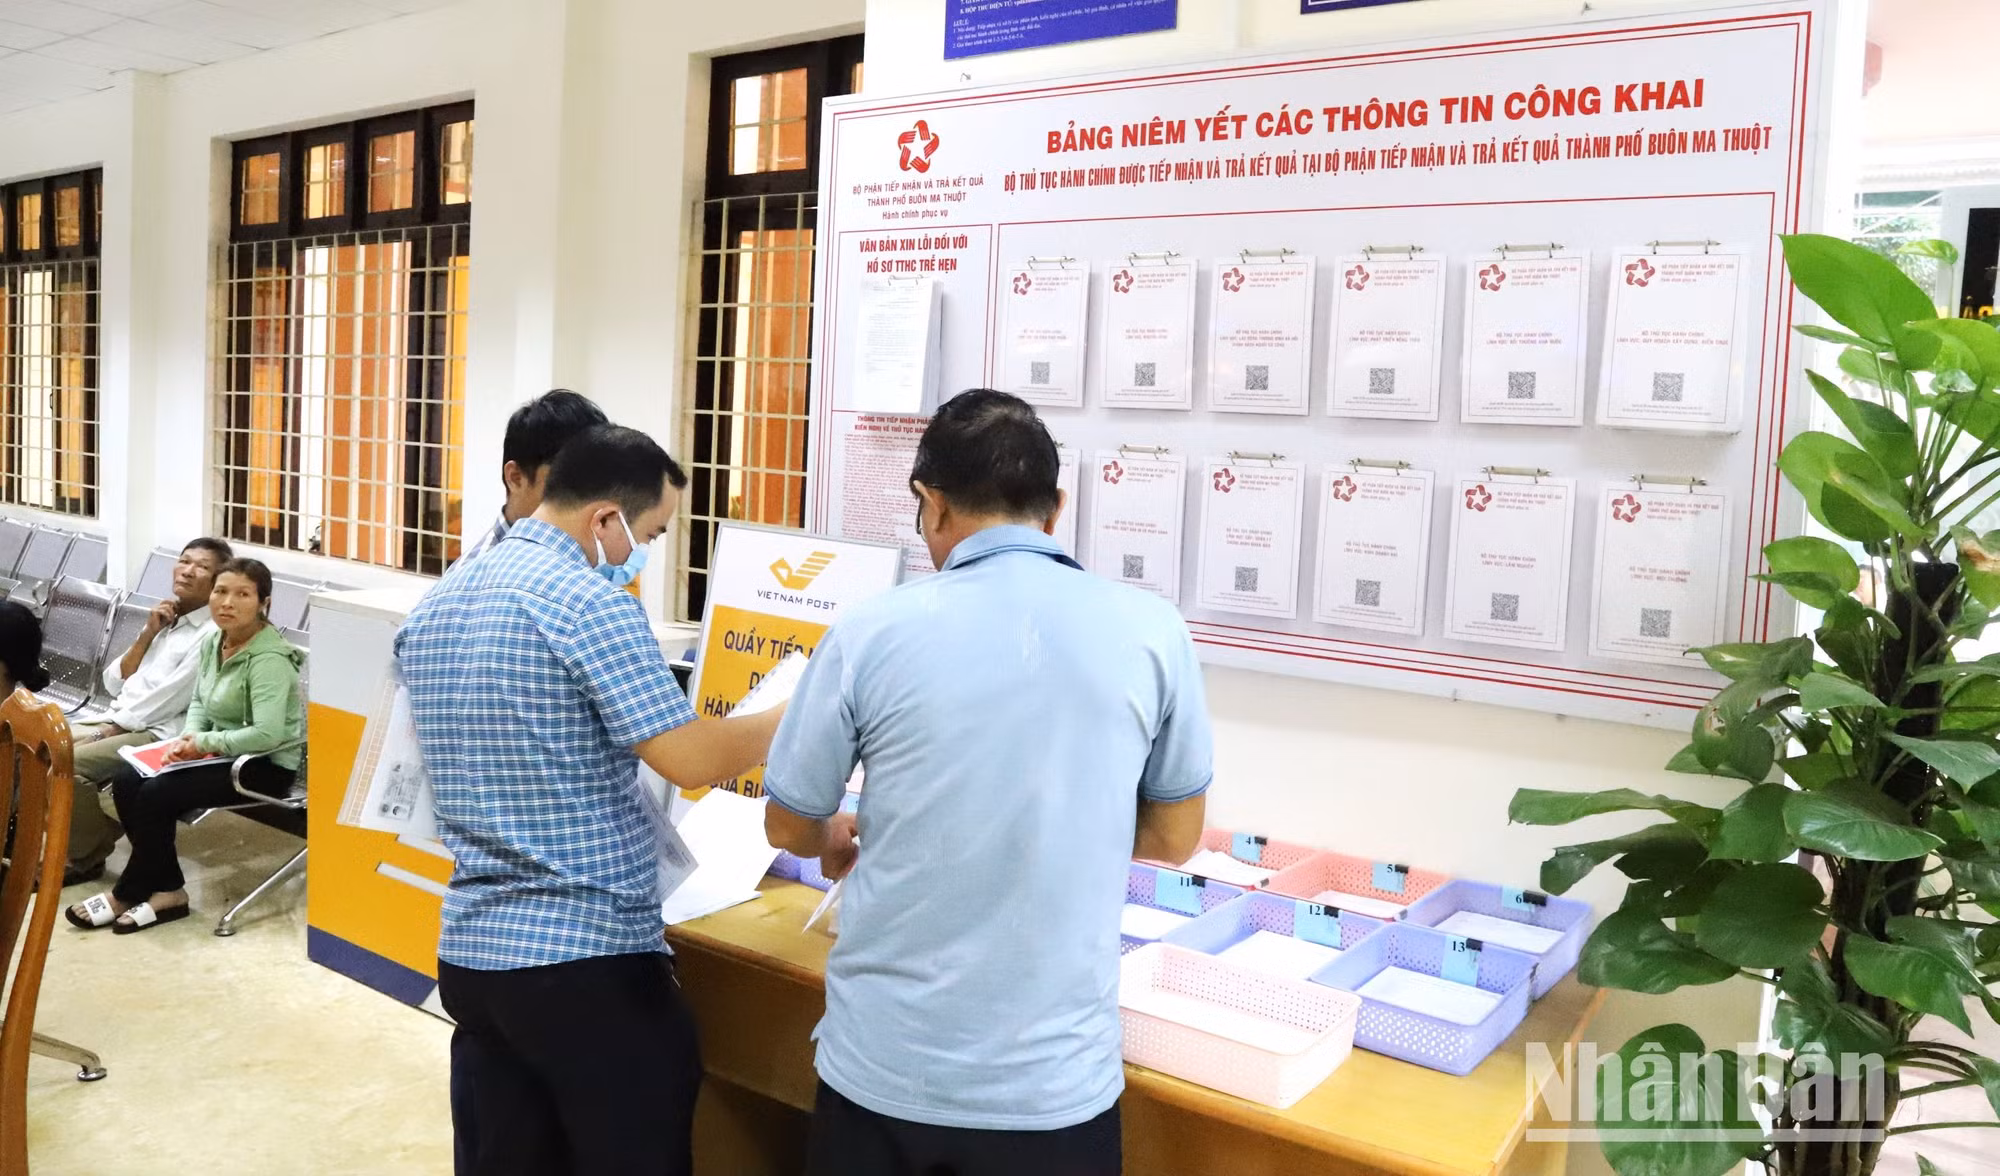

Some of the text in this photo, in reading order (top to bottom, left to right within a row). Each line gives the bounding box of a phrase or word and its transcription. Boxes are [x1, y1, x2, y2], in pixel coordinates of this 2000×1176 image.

[1047, 78, 1704, 153] BẢNG NIÊM YẾT CÁC THÔNG TIN CÔNG KHAI
[1004, 122, 1772, 195] BỘ THỦ TỤC HÀNH CHÍNH ĐƯỢC TIẾP NHẬN VÀ TRẢ KẾT QUẢ TẠI BỘ PHẬN TIẾP NHẬN VÀ TRẢ KẾT QUẢ THÀNH PHỐ BUÔN MA THUỘT
[853, 172, 984, 195] BỘ PHẬN TIẾP NHẬN VÀ TRẢ KẾT QUẢ
[868, 192, 966, 206] THÀNH PHỐ BUÔN MA THUỘT
[882, 211, 899, 220] Hành
[902, 210, 919, 218] chính
[922, 210, 938, 220] phục
[860, 233, 968, 252] VĂN BẢN XIN LỖI ĐỐI VỚI
[881, 259, 893, 272] SƠ
[896, 259, 917, 272] TTHC
[938, 258, 957, 274] HẸN
[757, 590, 837, 610] VIETNAM POST
[724, 626, 766, 656] QUẦY
[704, 694, 735, 718] HÀN
[1387, 864, 1393, 873] 5
[1179, 876, 1190, 887] 11
[1516, 894, 1522, 904] 6
[1309, 904, 1322, 915] 12
[1452, 941, 1465, 952] 13
